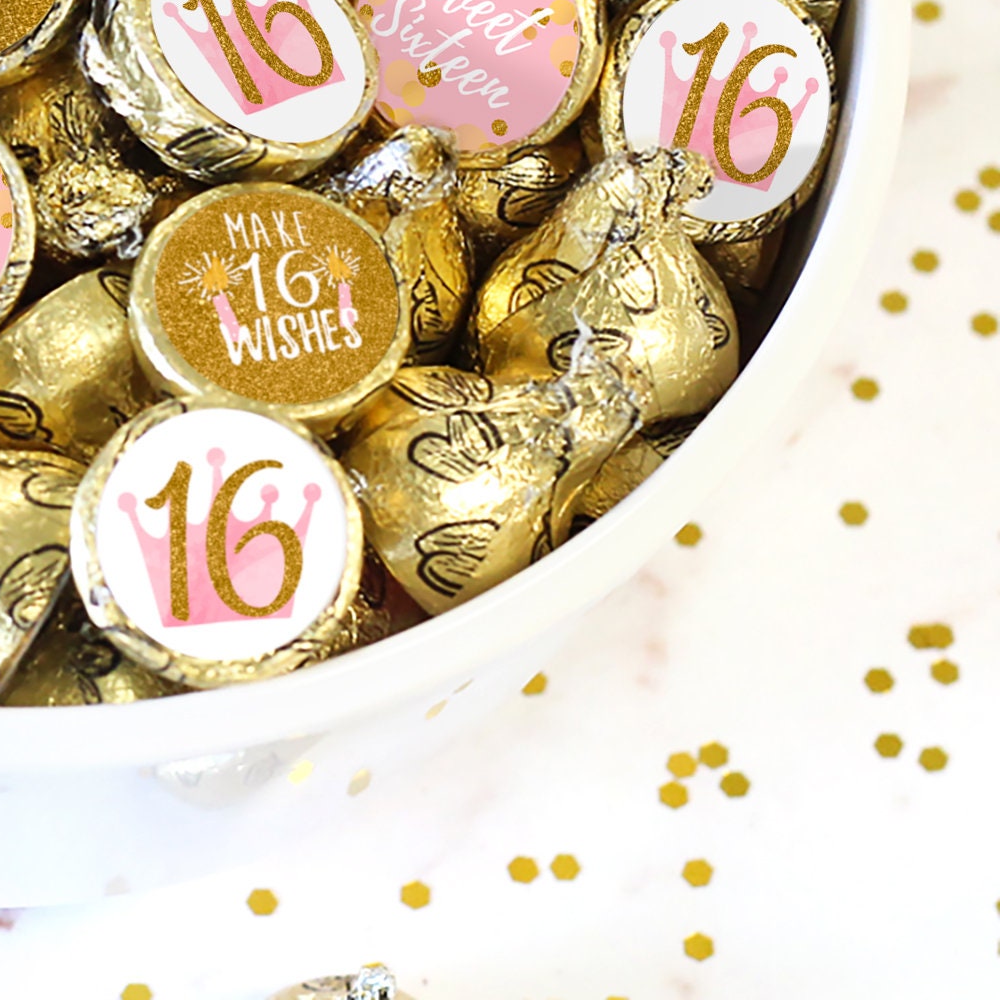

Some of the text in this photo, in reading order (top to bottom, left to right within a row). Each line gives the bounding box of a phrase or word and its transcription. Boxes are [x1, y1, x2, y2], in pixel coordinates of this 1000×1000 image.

[671, 21, 798, 184] 16
[222, 209, 309, 250] MAKE
[242, 249, 320, 310] 16
[218, 306, 363, 368] WISHES
[144, 459, 303, 621] 16
